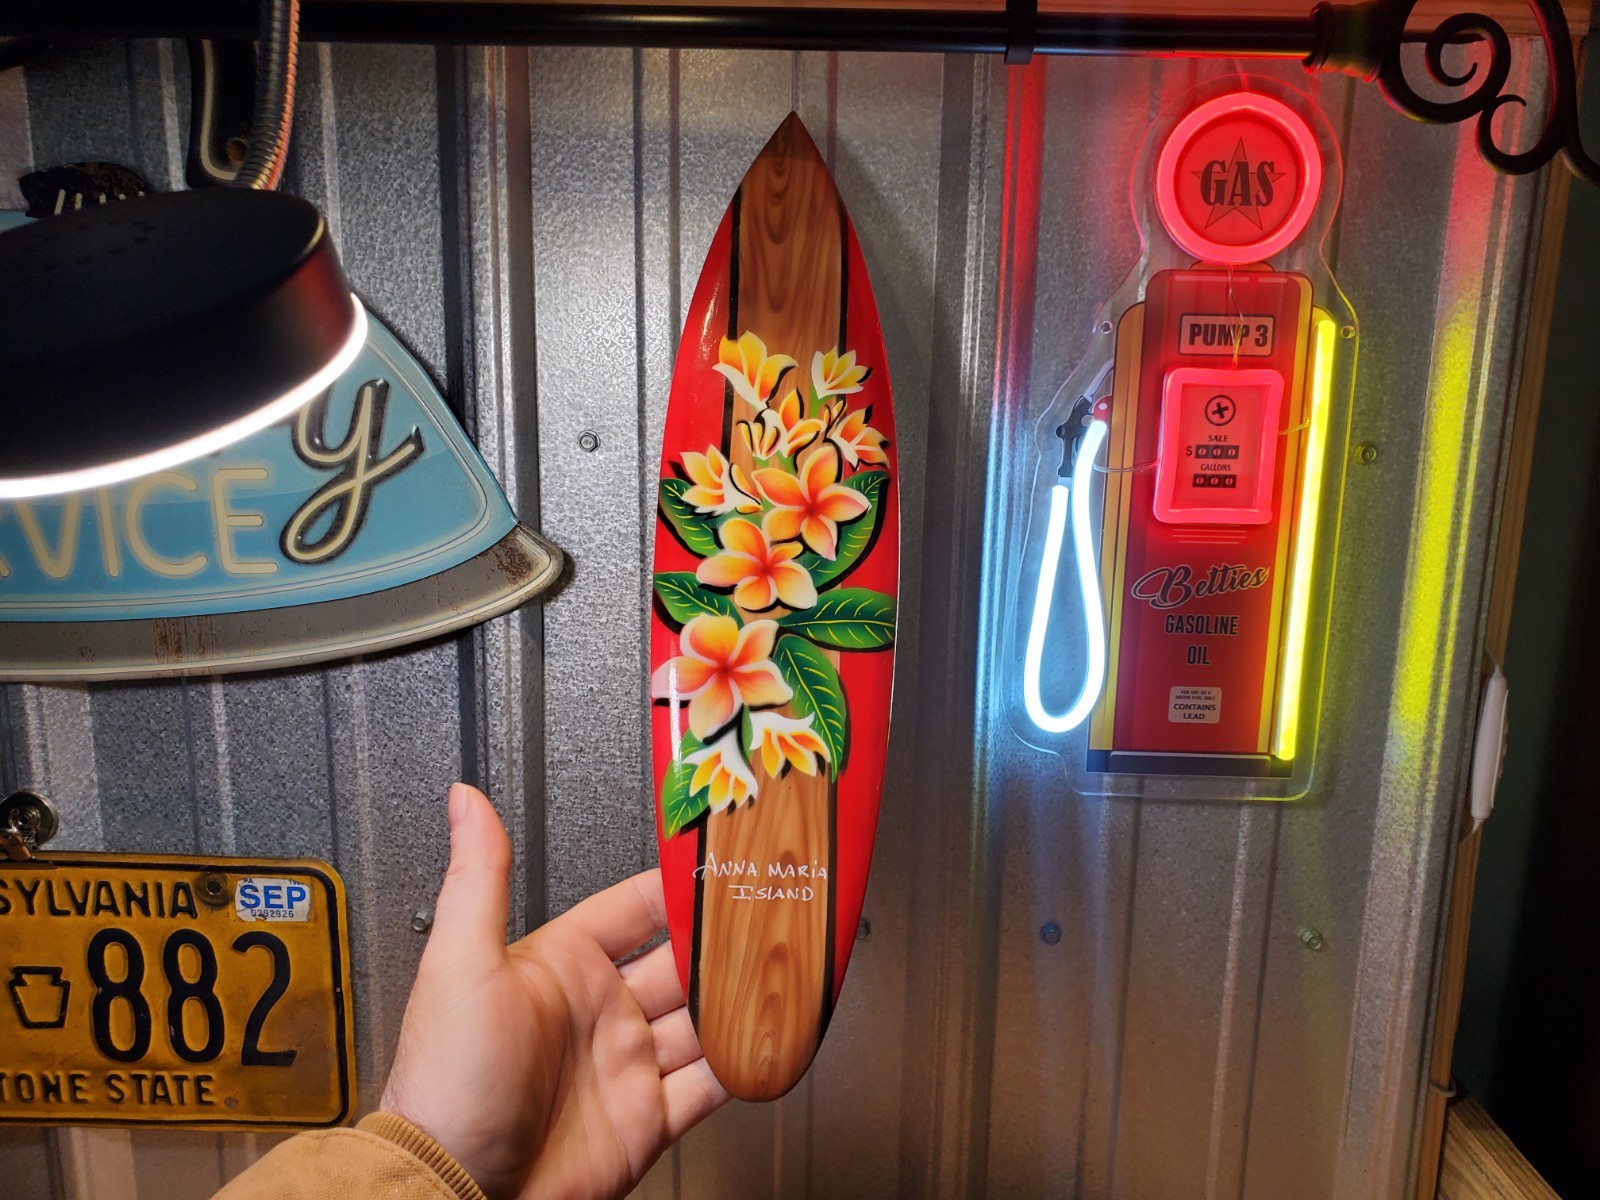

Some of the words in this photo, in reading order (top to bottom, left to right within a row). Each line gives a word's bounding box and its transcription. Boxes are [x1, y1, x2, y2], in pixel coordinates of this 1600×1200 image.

[1200, 159, 1275, 207] GAS
[1188, 322, 1250, 347] PUMP
[1254, 325, 1269, 348] 3
[1207, 434, 1229, 442] SALE
[1200, 463, 1232, 472] GALLONS
[1131, 563, 1270, 610] Betties
[1165, 614, 1239, 636] GASOLINE
[1187, 645, 1211, 666] OIL
[1173, 703, 1217, 711] CONTAINS
[1183, 712, 1206, 720] LEAD
[692, 851, 758, 880] ANNA
[239, 884, 307, 910] SEP
[728, 884, 815, 902] ISLAND
[87, 927, 298, 1067] 882
[105, 1073, 215, 1106] STATE
